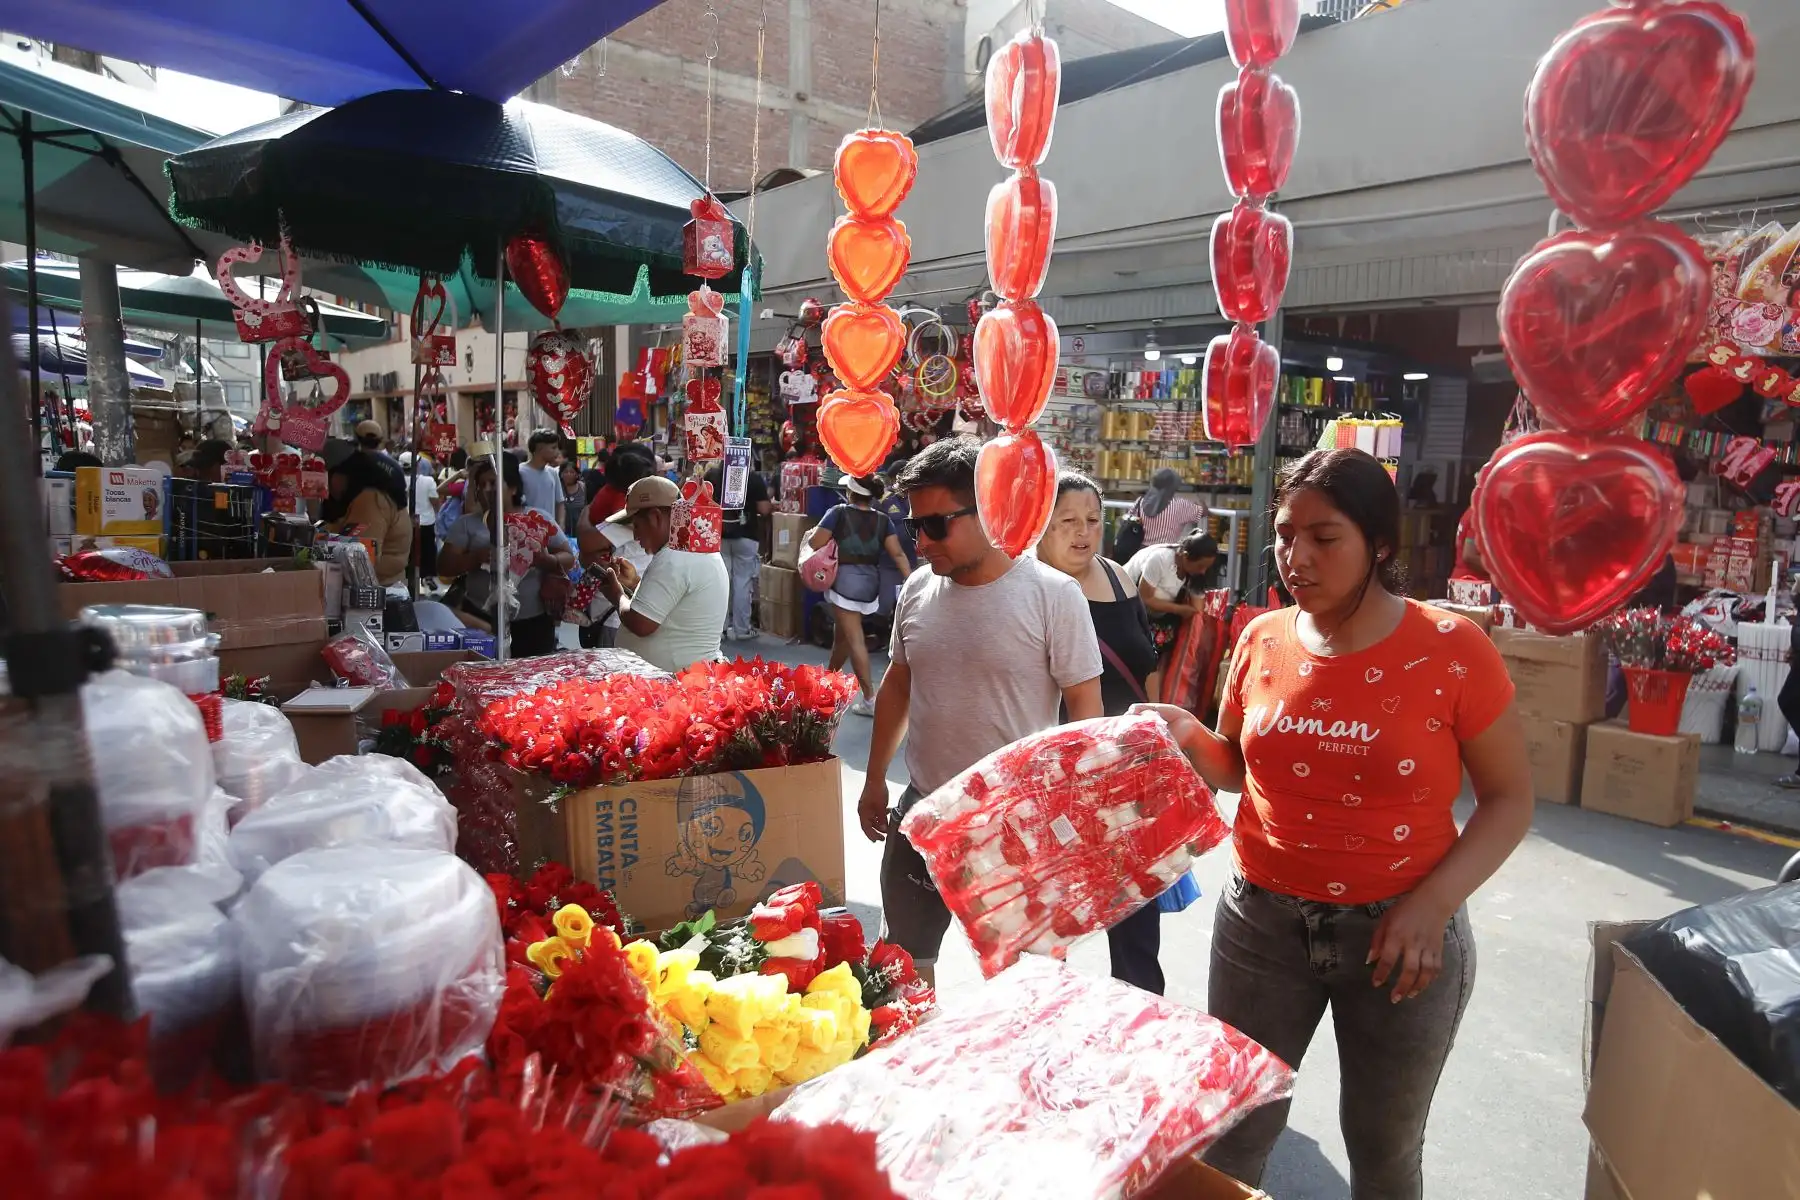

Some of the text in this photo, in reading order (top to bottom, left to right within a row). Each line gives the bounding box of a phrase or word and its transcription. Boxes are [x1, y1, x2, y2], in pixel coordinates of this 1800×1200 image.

[127, 478, 157, 486] Maketto
[105, 488, 126, 496] Tocas
[1404, 656, 1429, 671] Woman
[1246, 699, 1380, 743] Woman
[1317, 740, 1371, 756] PERFECT
[618, 797, 639, 869] CINTA
